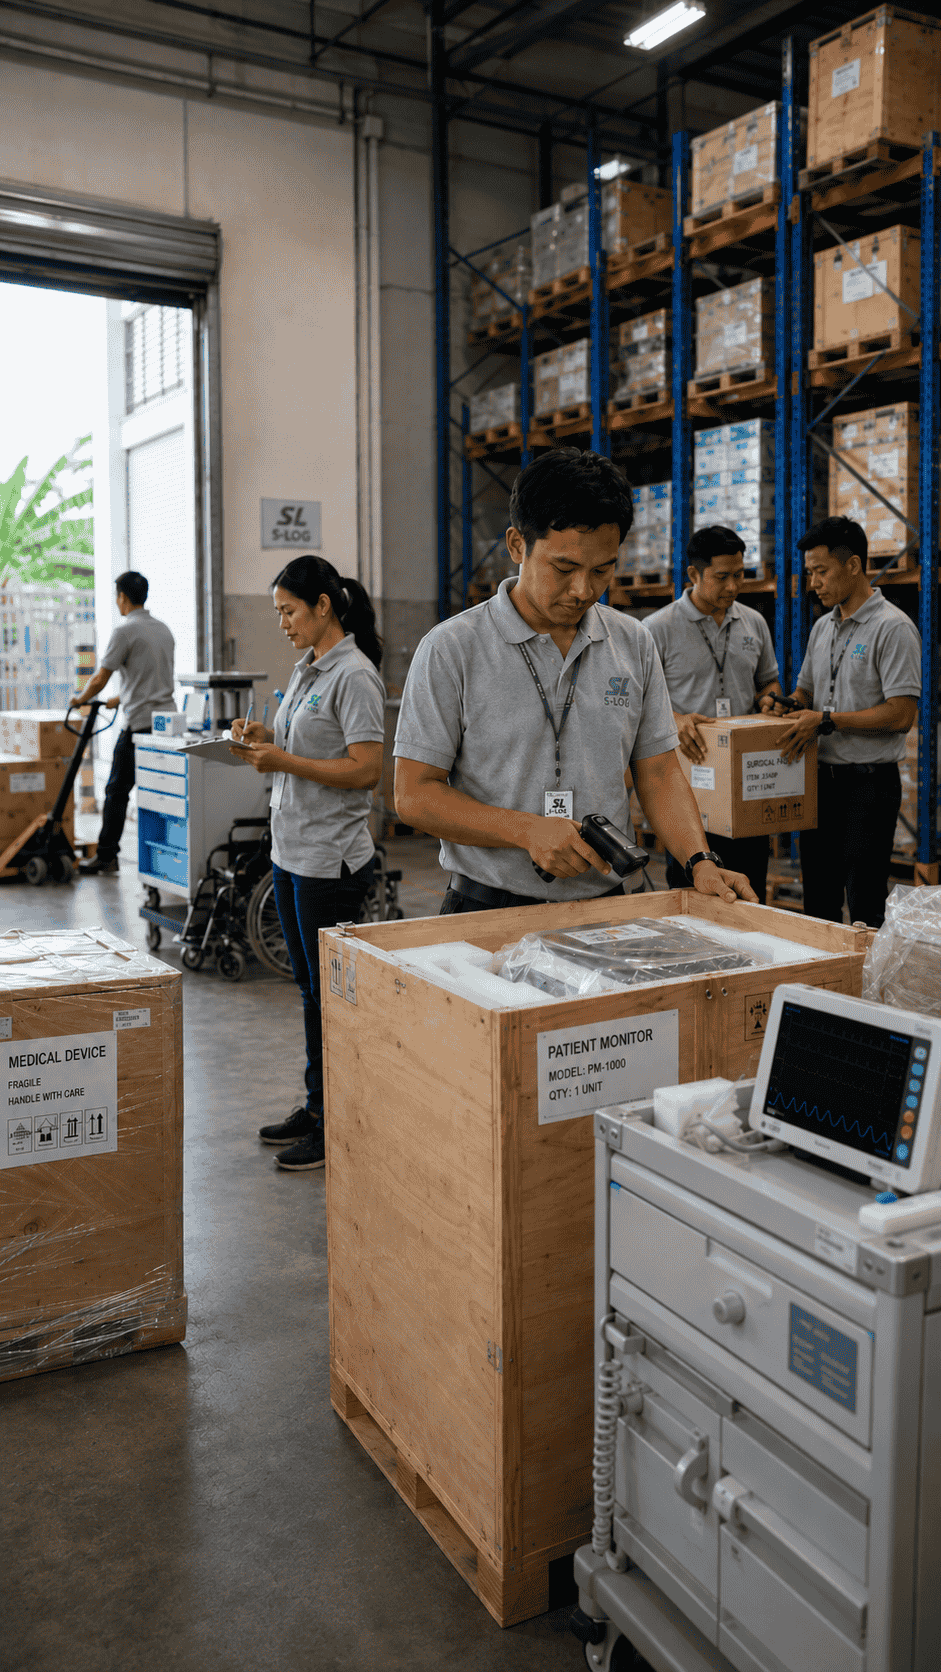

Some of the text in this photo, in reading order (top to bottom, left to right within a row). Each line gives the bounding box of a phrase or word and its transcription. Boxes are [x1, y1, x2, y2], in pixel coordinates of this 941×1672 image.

[276, 505, 307, 527] SL
[271, 529, 312, 542] S-LOG
[605, 676, 630, 697] SL
[552, 798, 566, 809] SL
[547, 1028, 654, 1059] PATIENT MONITOR
[8, 1045, 107, 1069] MEDICAL DEVICE
[548, 1057, 627, 1082] MODEL: PM-1000
[7, 1077, 42, 1090] FRAGILE
[548, 1080, 603, 1101] QTY: 1 UNIT
[8, 1087, 85, 1106] HANDLE WITH CARE
